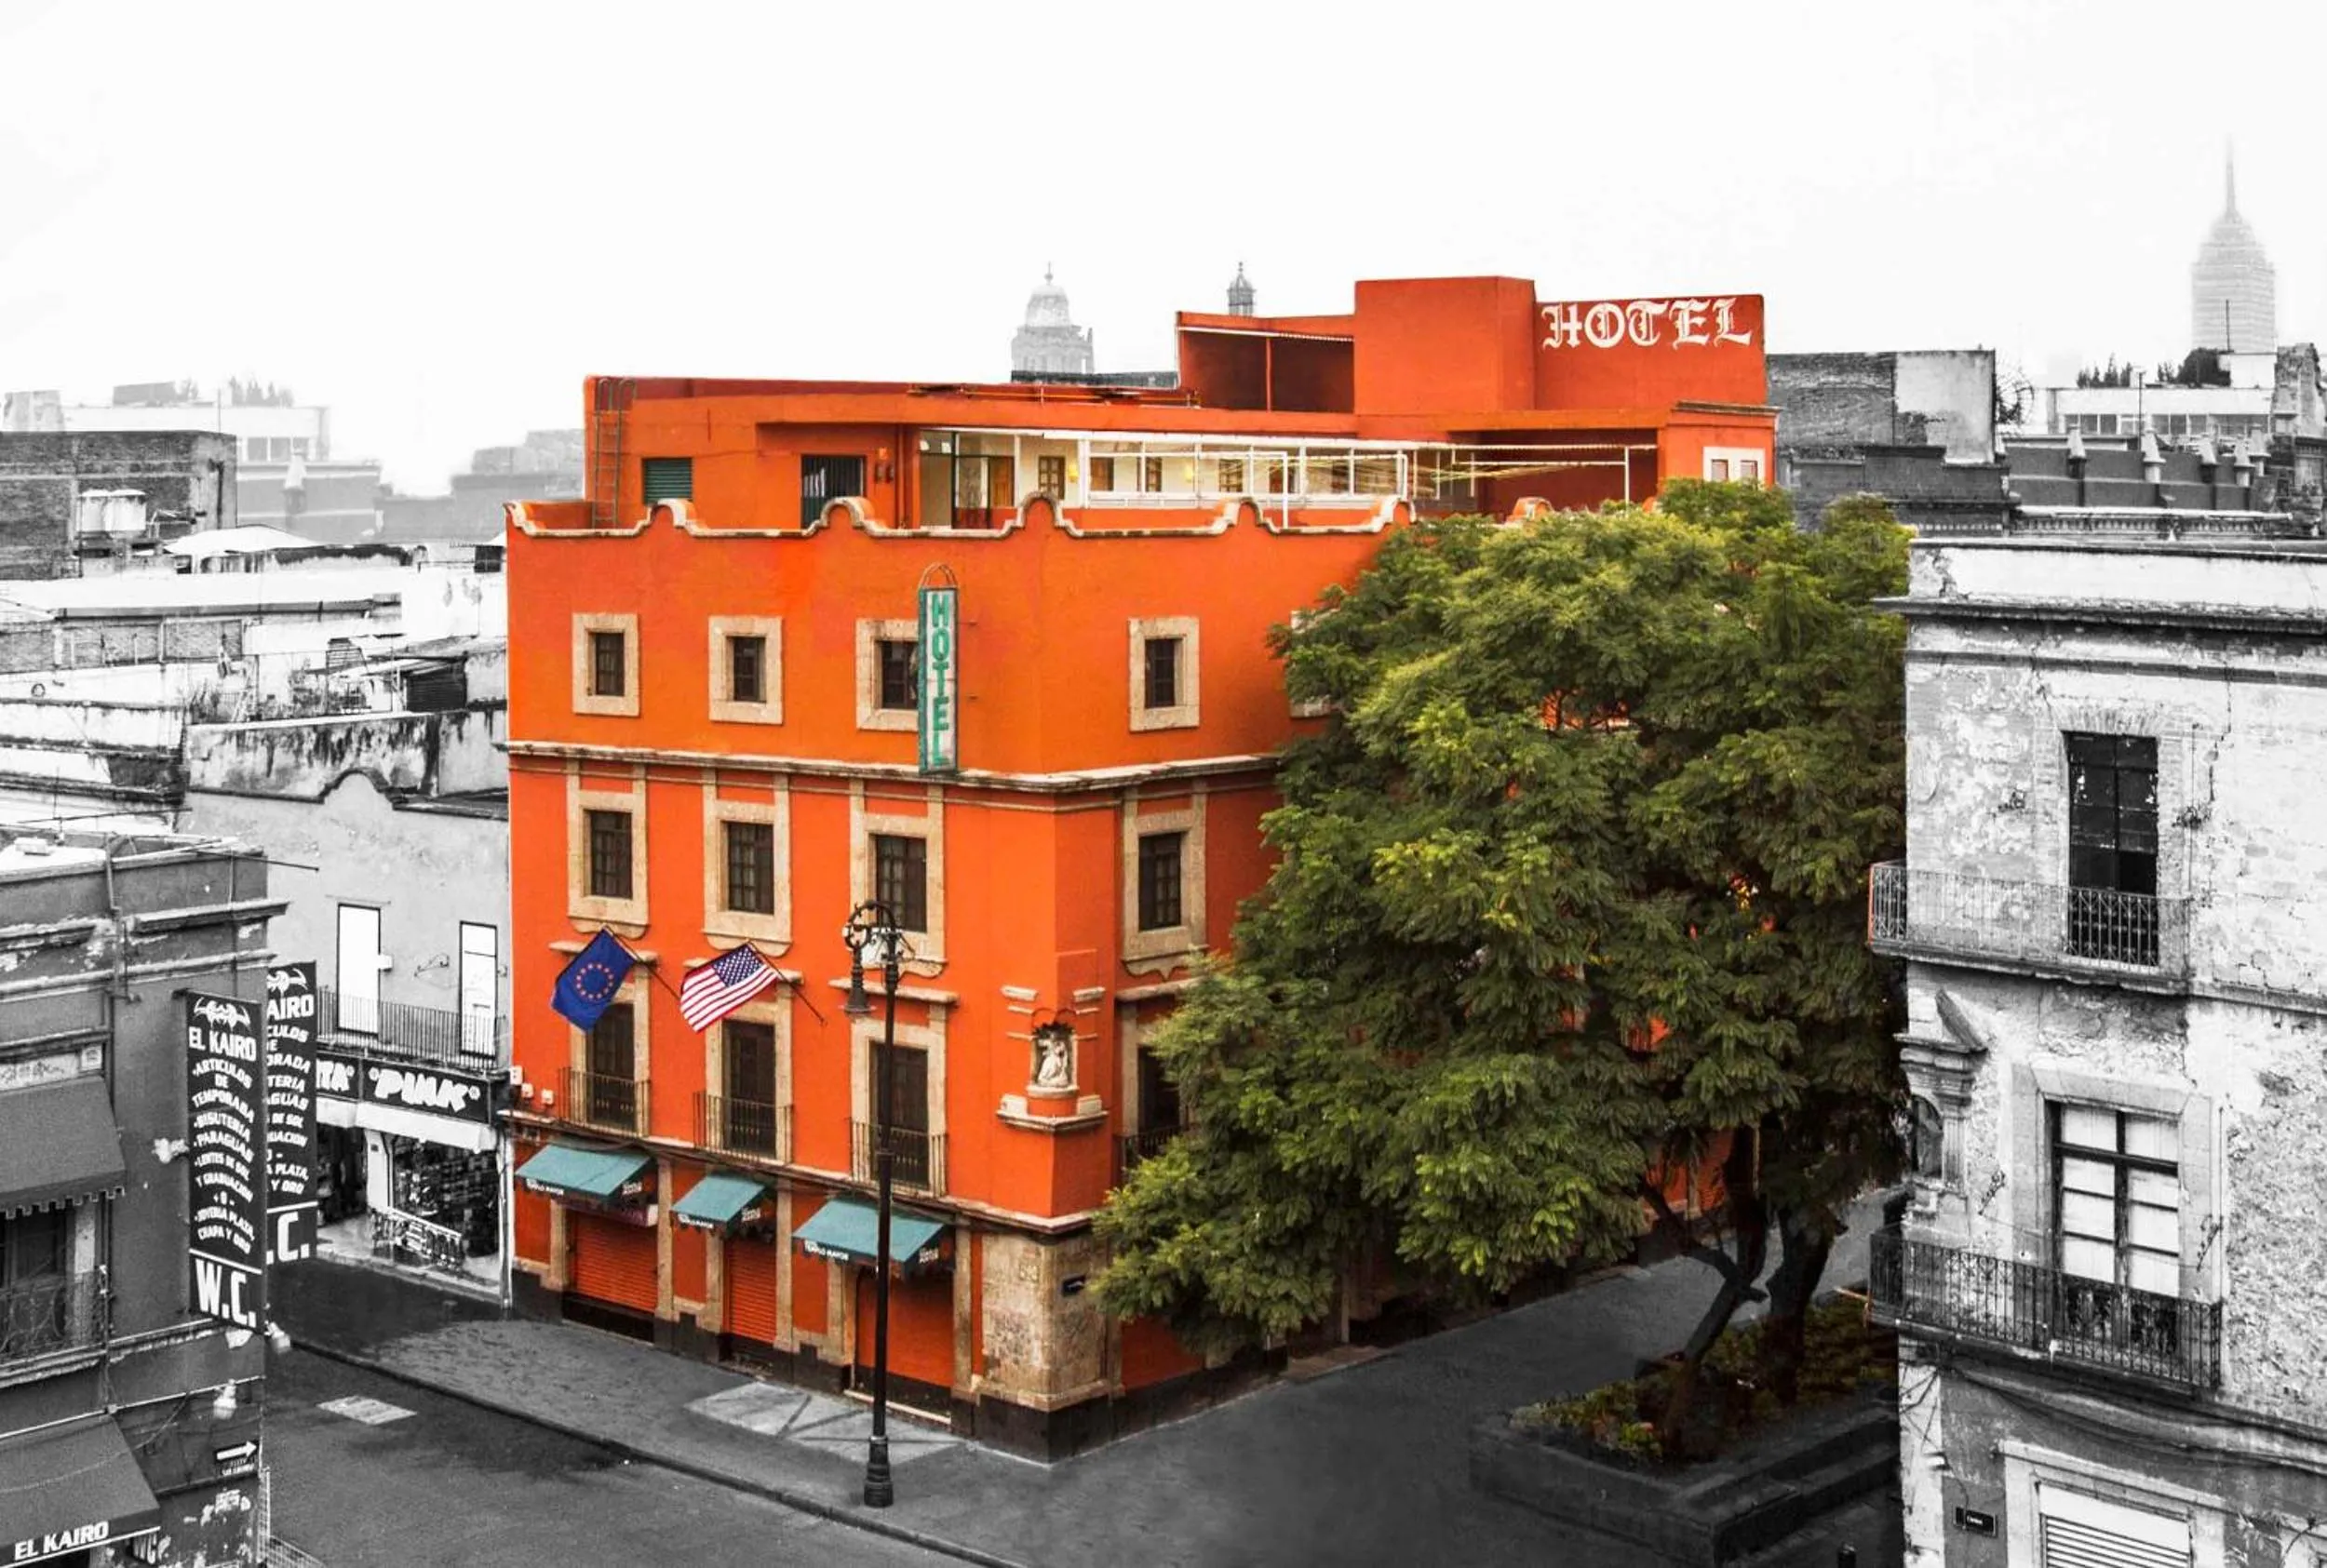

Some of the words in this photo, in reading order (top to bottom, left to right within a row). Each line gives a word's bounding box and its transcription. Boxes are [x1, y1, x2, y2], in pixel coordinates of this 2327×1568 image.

[1541, 297, 1752, 350] HOTEL
[932, 593, 950, 767] HOTEL
[266, 995, 314, 1021] AIRO
[189, 1026, 206, 1051] EL
[209, 1030, 256, 1061] KAIRO
[266, 1025, 308, 1042] CULOS
[195, 1058, 252, 1089] ARTICULOS
[266, 1053, 310, 1074] ORADA
[215, 1074, 229, 1089] DE
[266, 1075, 304, 1092] TERIA
[192, 1089, 254, 1123] TEMPORADA
[272, 1179, 279, 1191] Y
[226, 1227, 232, 1240] Y
[266, 1212, 309, 1265] .C.
[195, 1258, 257, 1328] W.C.
[14, 1538, 38, 1561] EL
[43, 1520, 109, 1554] KAIRO
